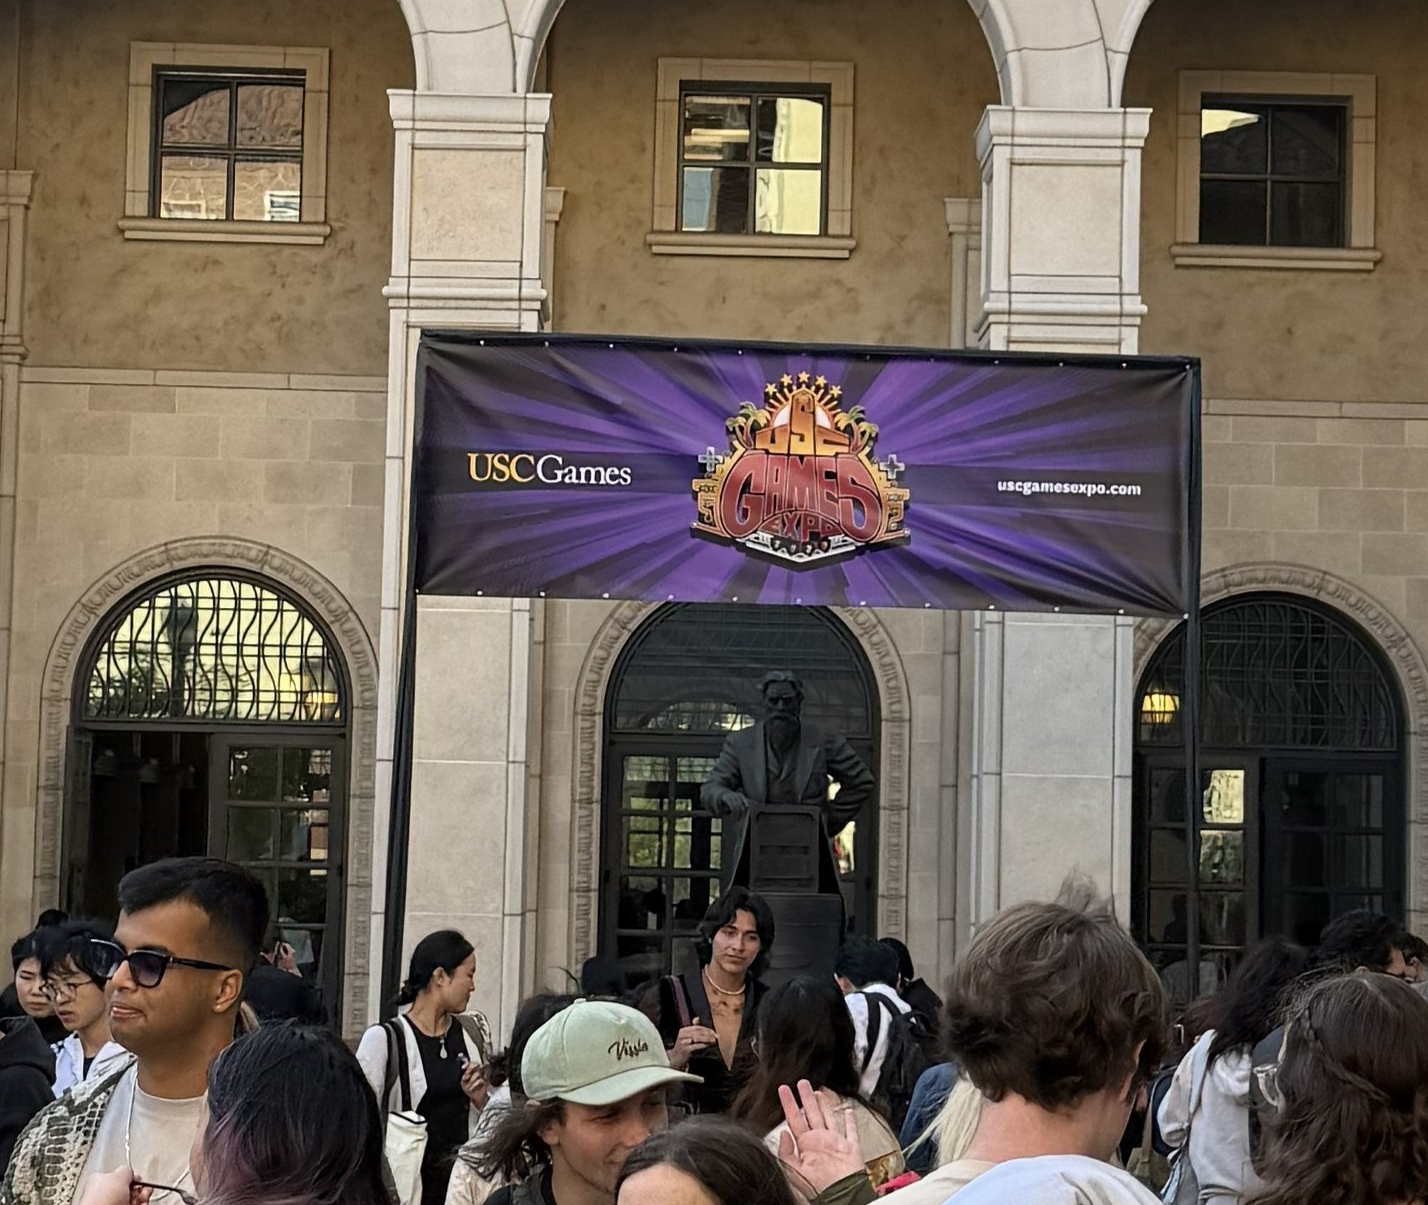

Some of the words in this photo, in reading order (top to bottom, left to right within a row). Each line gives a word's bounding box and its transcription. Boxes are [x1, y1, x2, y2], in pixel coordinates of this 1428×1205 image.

[755, 388, 850, 455] USC
[722, 450, 882, 542] GAMES
[997, 480, 1141, 497] uscgamesexpo.com
[758, 510, 845, 543] EXPO
